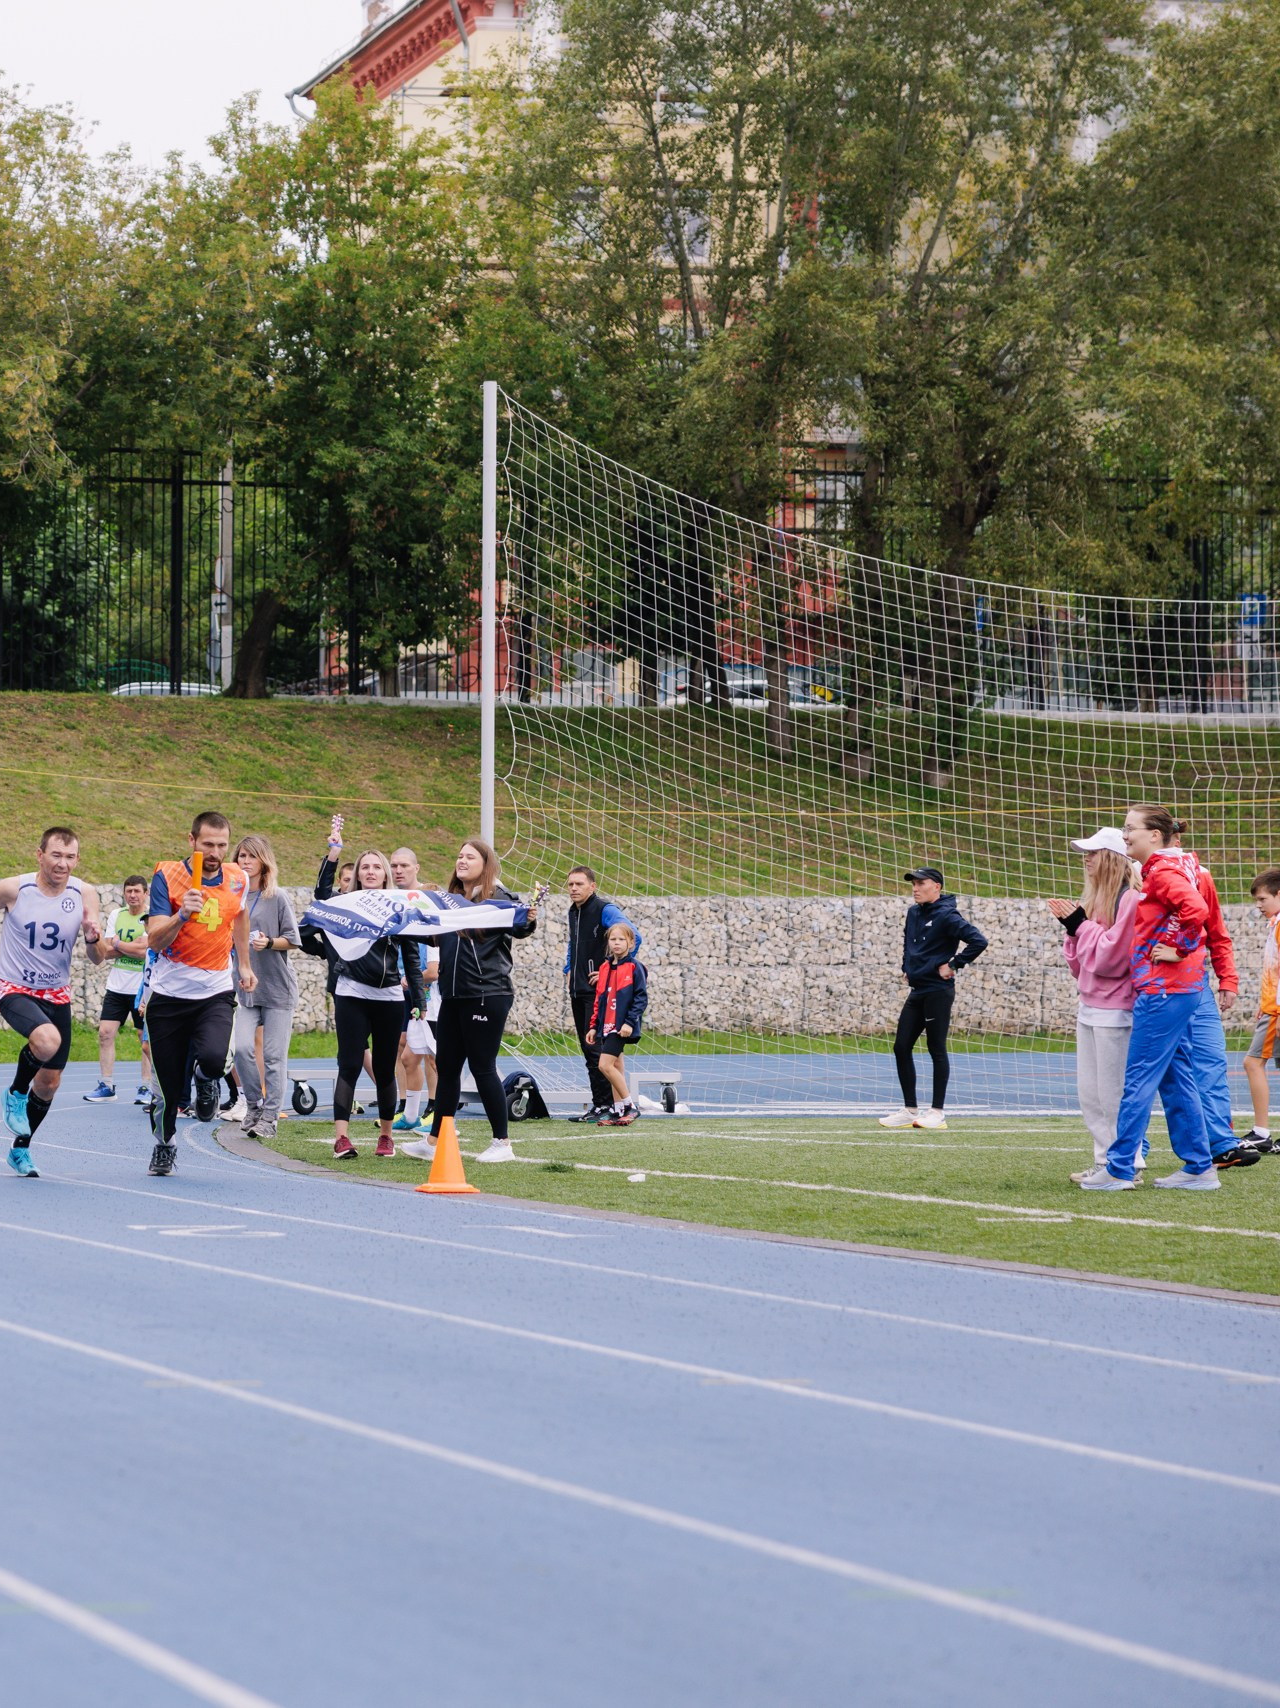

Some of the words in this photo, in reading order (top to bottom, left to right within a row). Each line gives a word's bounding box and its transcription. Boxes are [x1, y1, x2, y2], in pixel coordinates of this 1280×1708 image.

[196, 897, 223, 932] 4
[24, 921, 61, 951] 13
[117, 928, 136, 942] 15
[472, 1014, 489, 1022] FILA
